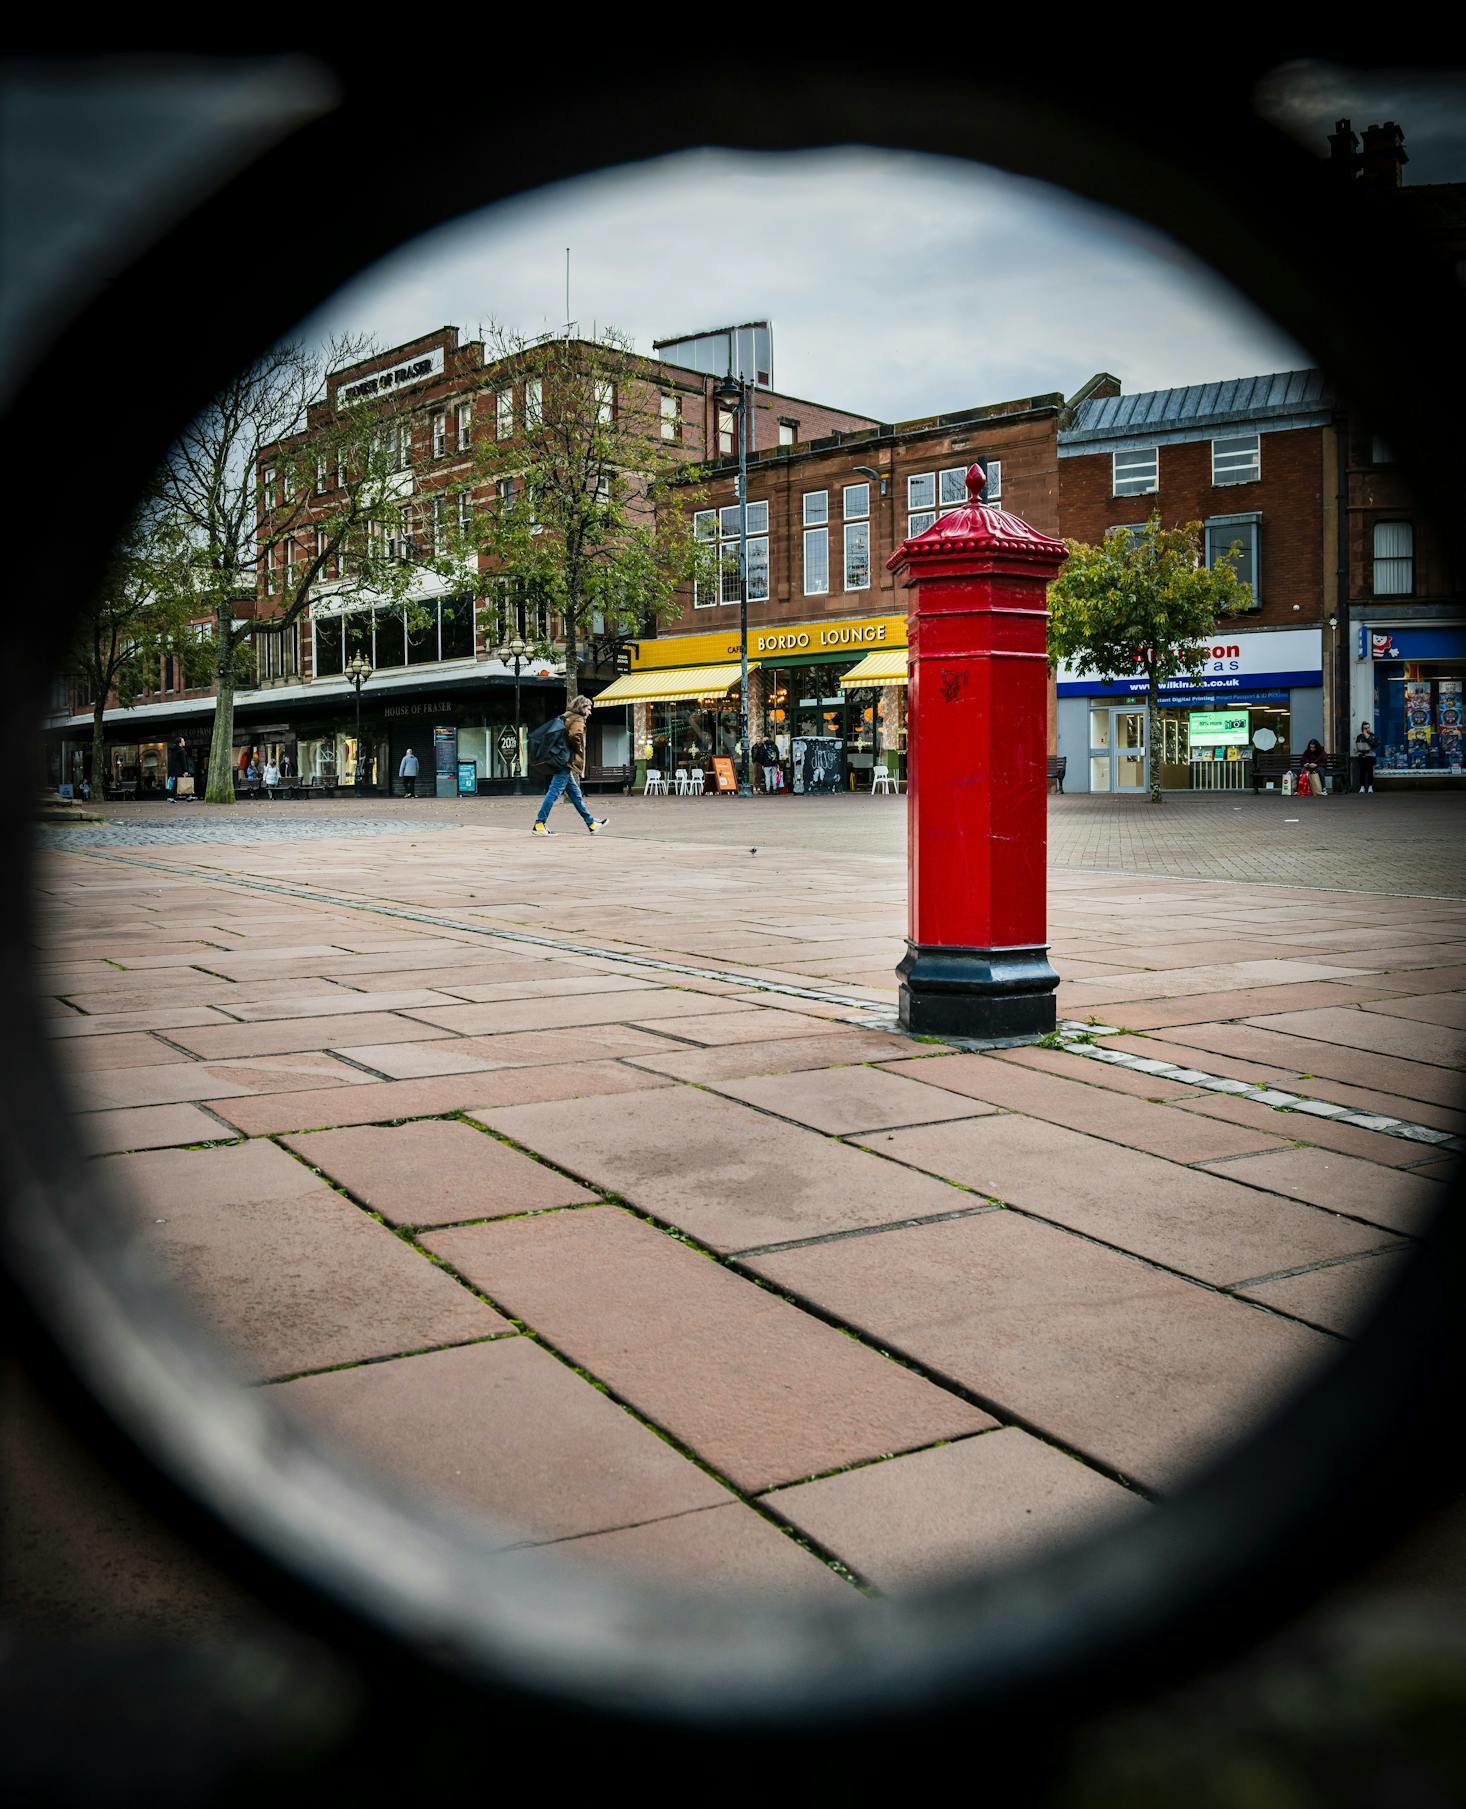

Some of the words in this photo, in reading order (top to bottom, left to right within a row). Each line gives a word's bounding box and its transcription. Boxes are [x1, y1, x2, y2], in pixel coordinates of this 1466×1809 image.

[758, 633, 810, 651] BORDO
[821, 625, 886, 645] LOUNGE
[1172, 696, 1191, 704] Digital
[1191, 694, 1215, 703] Printing
[384, 704, 409, 717] HOUSE
[411, 704, 422, 714] OF
[423, 701, 452, 713] FRASER
[501, 736, 517, 749] 20%
